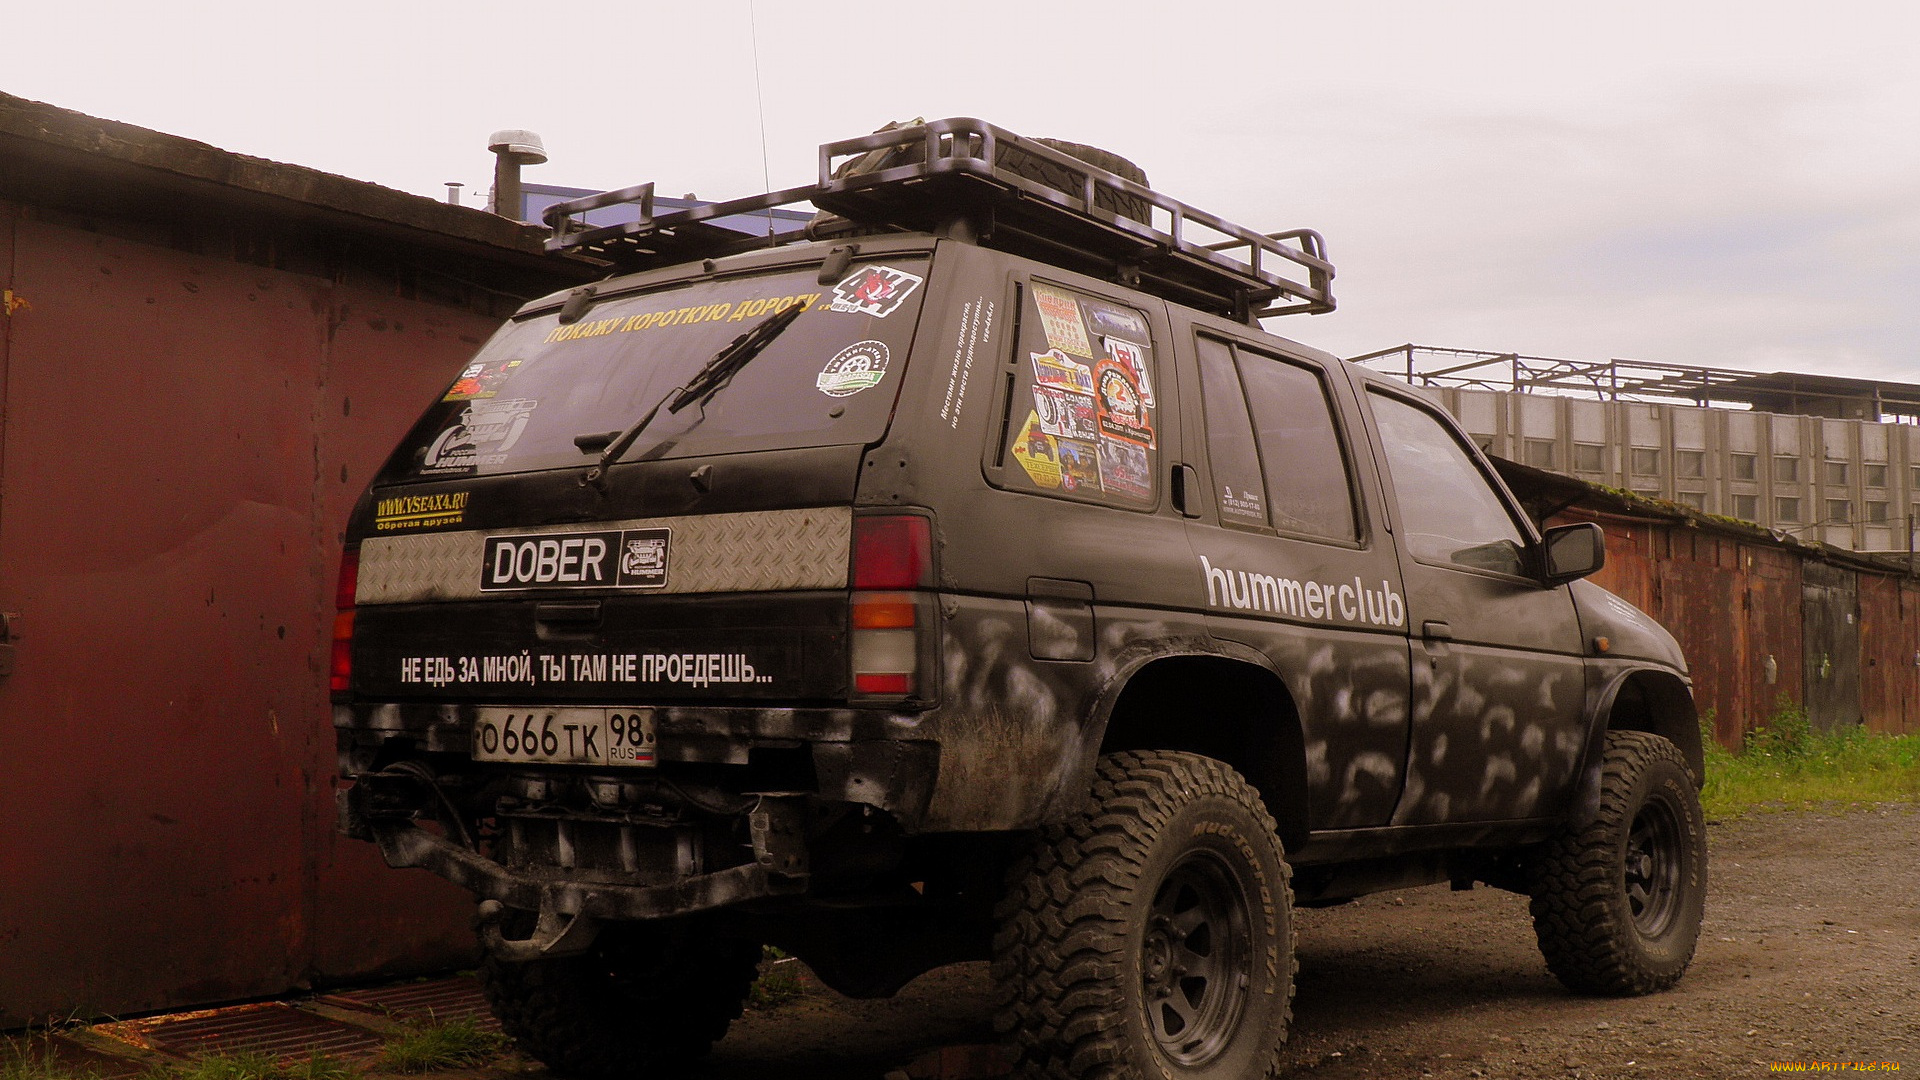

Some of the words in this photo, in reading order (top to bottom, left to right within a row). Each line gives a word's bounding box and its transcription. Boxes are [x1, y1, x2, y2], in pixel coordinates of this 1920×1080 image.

[543, 316, 624, 344] ПОКАЖУ
[623, 302, 729, 332] КОРОТКУЮ
[727, 292, 821, 322] ДОРОГУ
[951, 348, 962, 379] жизнь
[957, 301, 971, 348] прекрасна,
[959, 373, 969, 399] места
[1111, 379, 1127, 403] 2
[954, 401, 963, 415] эти
[951, 415, 958, 429] но
[377, 492, 470, 518] WWW.VSE4X4.RU
[377, 521, 421, 531] Обретая
[422, 515, 464, 528] друзей
[493, 538, 607, 584] DOBER
[401, 656, 423, 684] НЕ
[424, 656, 456, 688] ЕДЬ
[458, 656, 480, 684] ЗА
[483, 650, 536, 686] МНОЙ,
[540, 655, 568, 683] ТЫ
[571, 655, 607, 683] ТАМ
[612, 654, 637, 682] НЕ
[641, 653, 774, 689] ПРОЕДЕШЬ...
[611, 713, 644, 747] 98
[611, 747, 635, 760] RUS
[1192, 821, 1276, 937] Mud-Terrain
